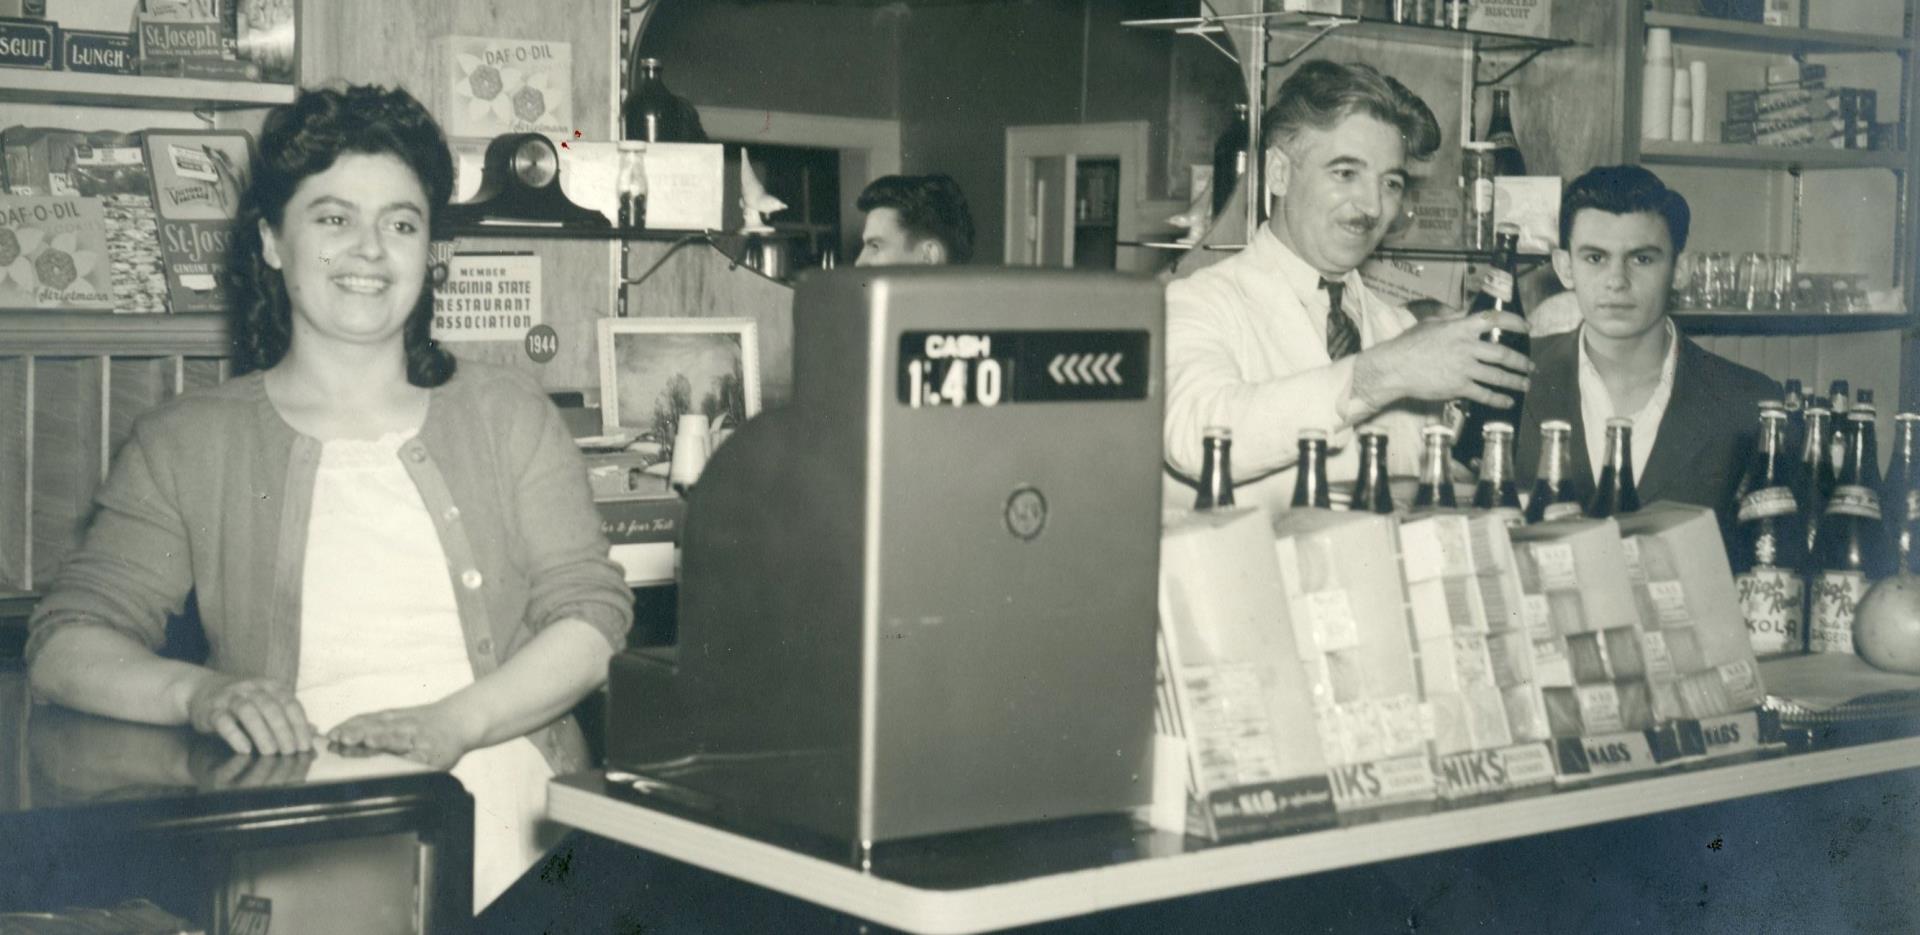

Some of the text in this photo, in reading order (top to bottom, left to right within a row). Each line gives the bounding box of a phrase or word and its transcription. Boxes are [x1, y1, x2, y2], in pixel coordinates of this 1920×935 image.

[1484, 7, 1530, 19] BISCUIT
[72, 44, 124, 68] LUNCH
[460, 268, 507, 277] MEMBER
[498, 281, 531, 294] STATE
[435, 298, 531, 312] RESTAURANT
[435, 315, 532, 329] ASSOCIATION
[529, 335, 556, 354] 1944
[925, 334, 991, 359] CASH
[1744, 618, 1798, 638] KOLA
[1704, 722, 1740, 747] NABS
[1587, 742, 1632, 765] NABS
[1441, 749, 1505, 790] NIKS
